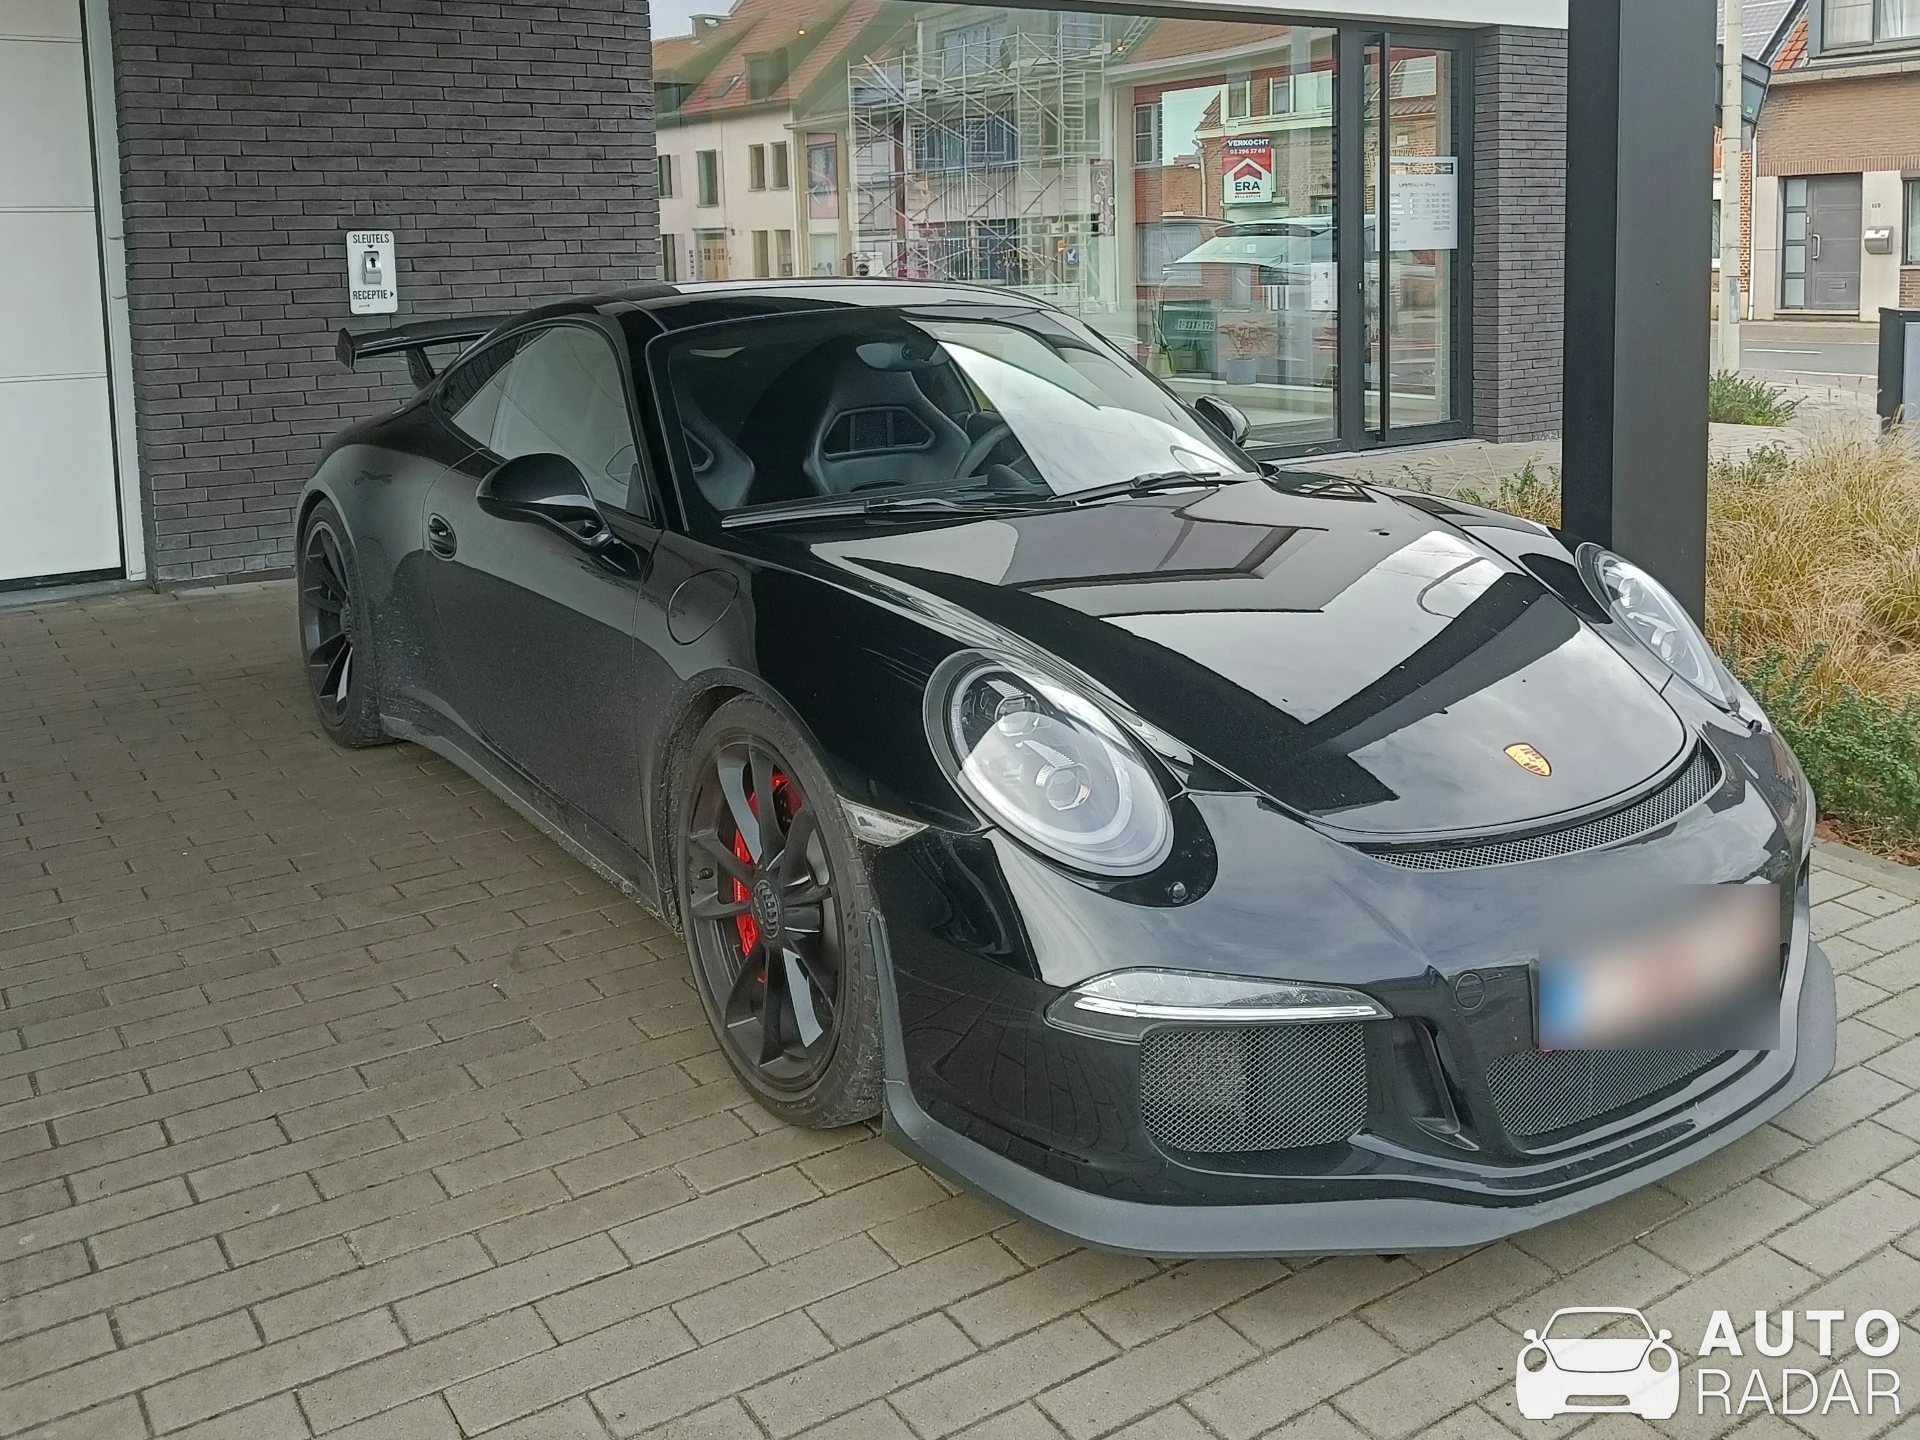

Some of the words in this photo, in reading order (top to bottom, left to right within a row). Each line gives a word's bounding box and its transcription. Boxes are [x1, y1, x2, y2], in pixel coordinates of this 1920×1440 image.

[1227, 138, 1269, 147] VERKOCHT
[1234, 181, 1261, 191] ERA
[352, 233, 390, 244] SLEUTELS
[352, 289, 388, 300] RECEPTIE
